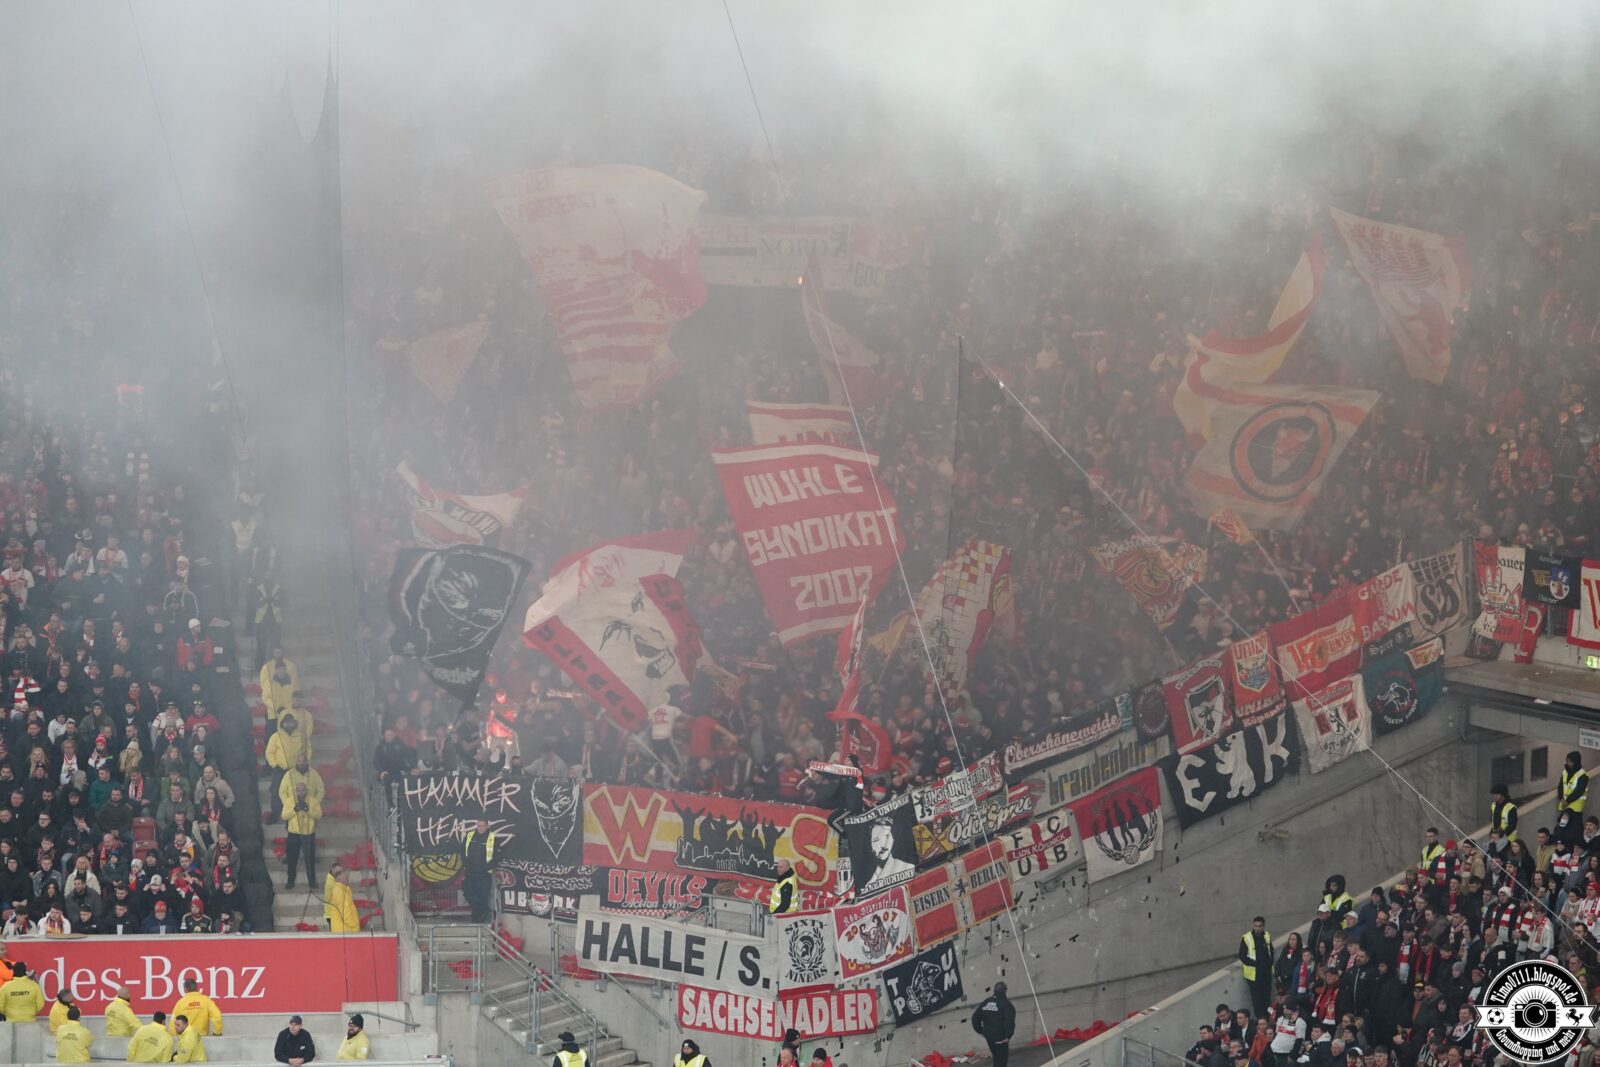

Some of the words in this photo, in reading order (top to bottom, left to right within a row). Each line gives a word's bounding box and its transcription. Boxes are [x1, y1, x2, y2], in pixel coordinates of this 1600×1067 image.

[744, 464, 864, 508] WUHLE
[743, 507, 898, 566] SYNDIKAT
[790, 565, 873, 611] 2002
[1358, 568, 1401, 597] GARDE
[1004, 712, 1121, 766] Oberschöneweide
[403, 776, 521, 813] HAMMER
[607, 868, 707, 909] DEVILS
[912, 885, 951, 915] EISERN
[970, 861, 1007, 889] BERLIN
[582, 920, 706, 977] HALLE
[784, 919, 828, 934] SIXTY
[784, 966, 828, 983] NINERS
[681, 986, 875, 1038] SACHSENADLER
